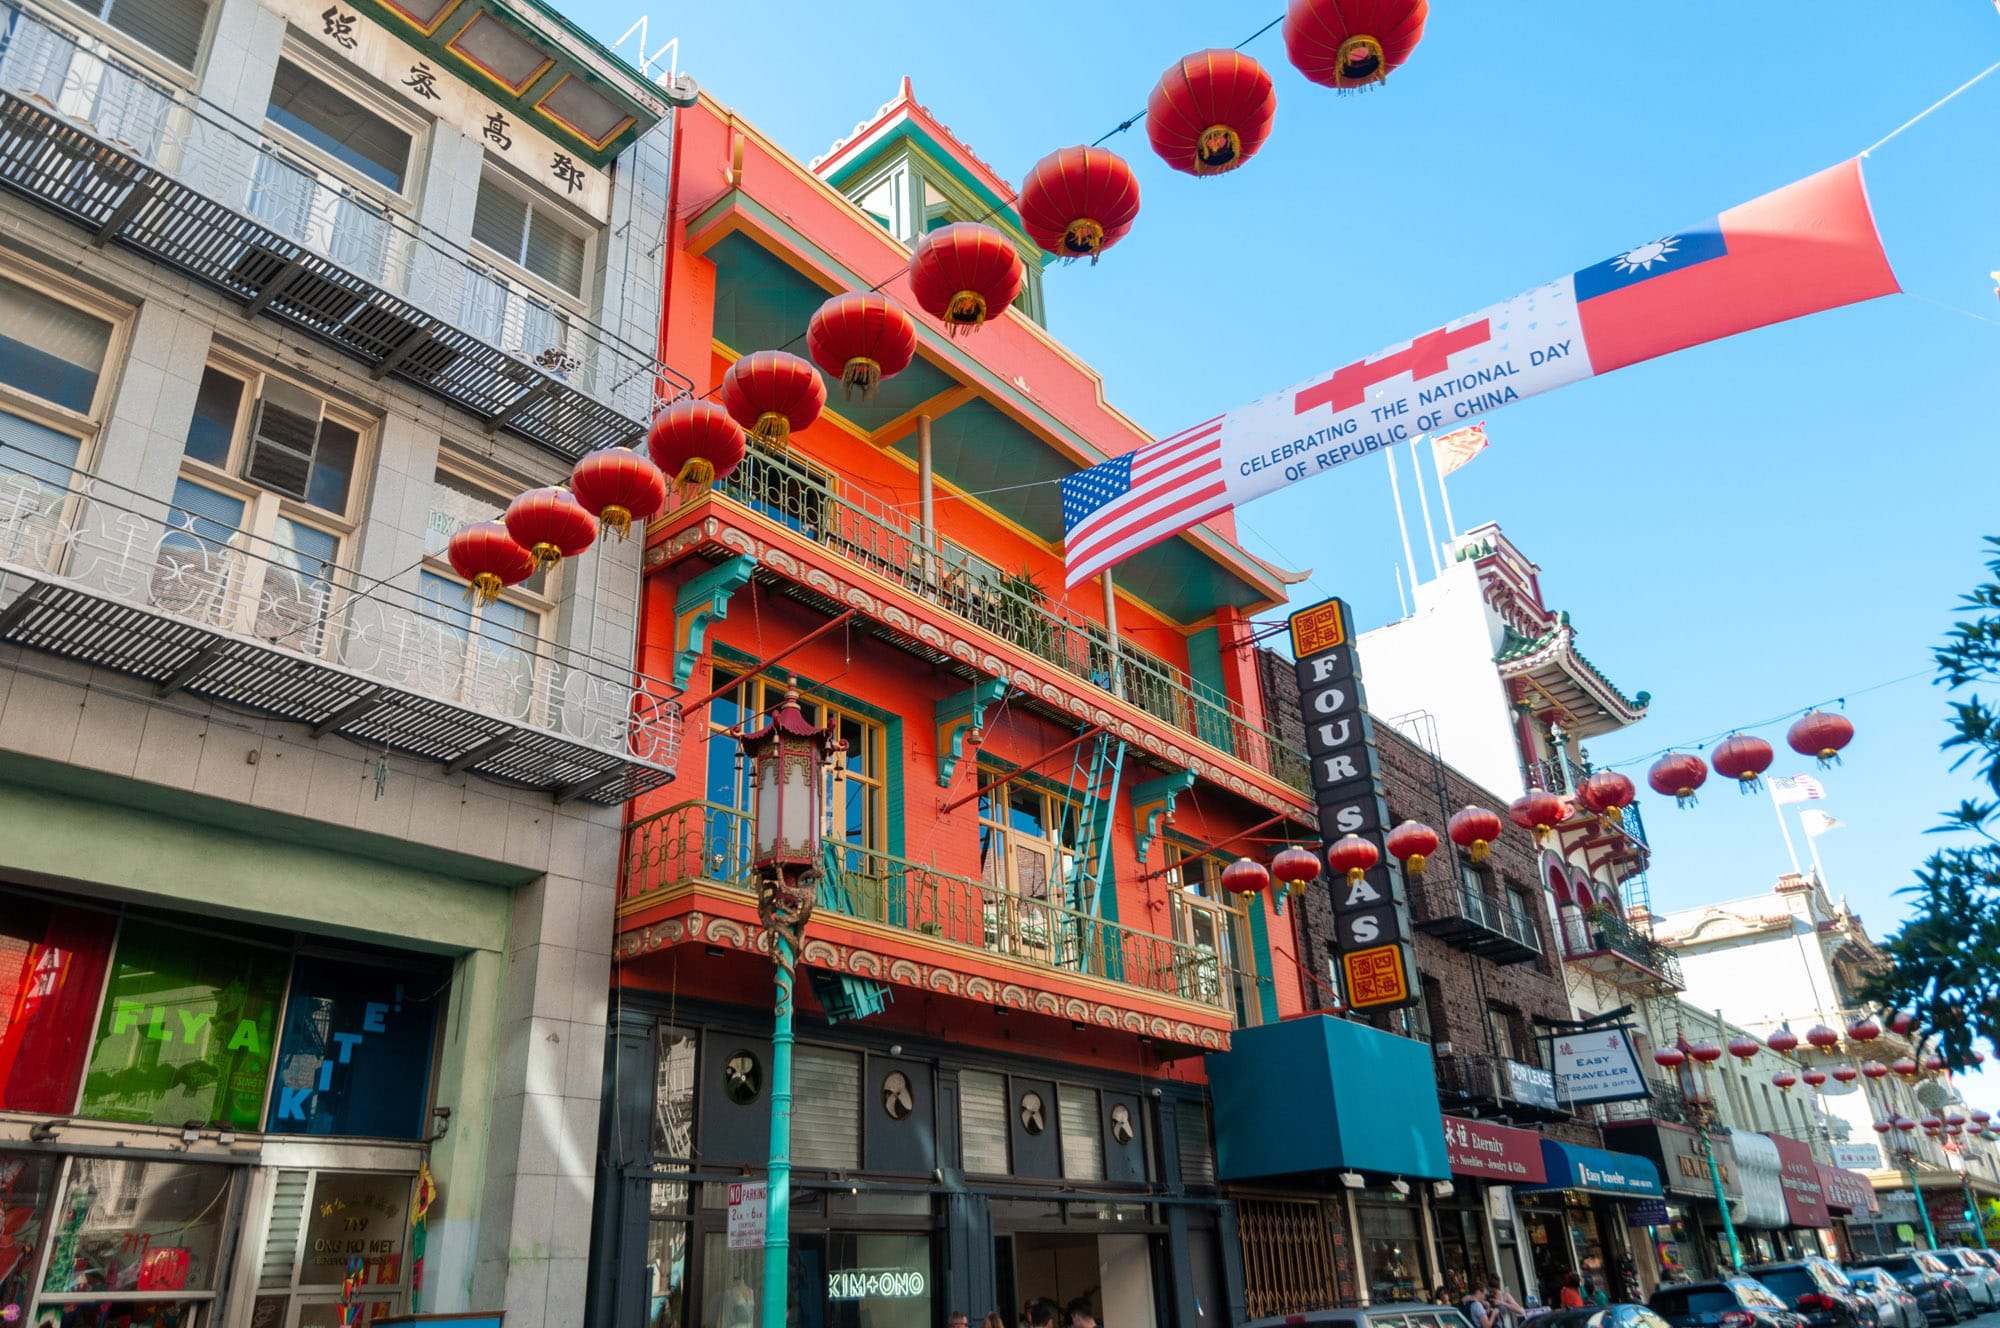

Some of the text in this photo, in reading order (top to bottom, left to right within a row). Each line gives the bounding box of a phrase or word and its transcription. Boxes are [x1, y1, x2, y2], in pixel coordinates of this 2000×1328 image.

[1240, 339, 1571, 476] CELEBRATING THE NATIONAL DAY
[1285, 385, 1519, 481] OF REPUBLIC OF CHINA
[1311, 653, 1381, 944] FOUR SAS
[113, 1000, 210, 1044] FLY
[227, 1019, 260, 1053] A
[1576, 1056, 1610, 1066] EASY
[1511, 1063, 1553, 1089] FOR LEASE
[1564, 1067, 1628, 1080] TRAVELER
[1612, 1079, 1636, 1088] GIFTS
[1471, 1132, 1504, 1157] Eternity
[1585, 1168, 1601, 1185] Easy
[1601, 1170, 1625, 1185] Traveler
[729, 1185, 767, 1204] NO PARKING
[344, 1217, 368, 1232] 719
[122, 1232, 151, 1256] 717
[315, 1239, 395, 1253] ONG KO MET
[829, 1272, 924, 1298] KIM+ONO
